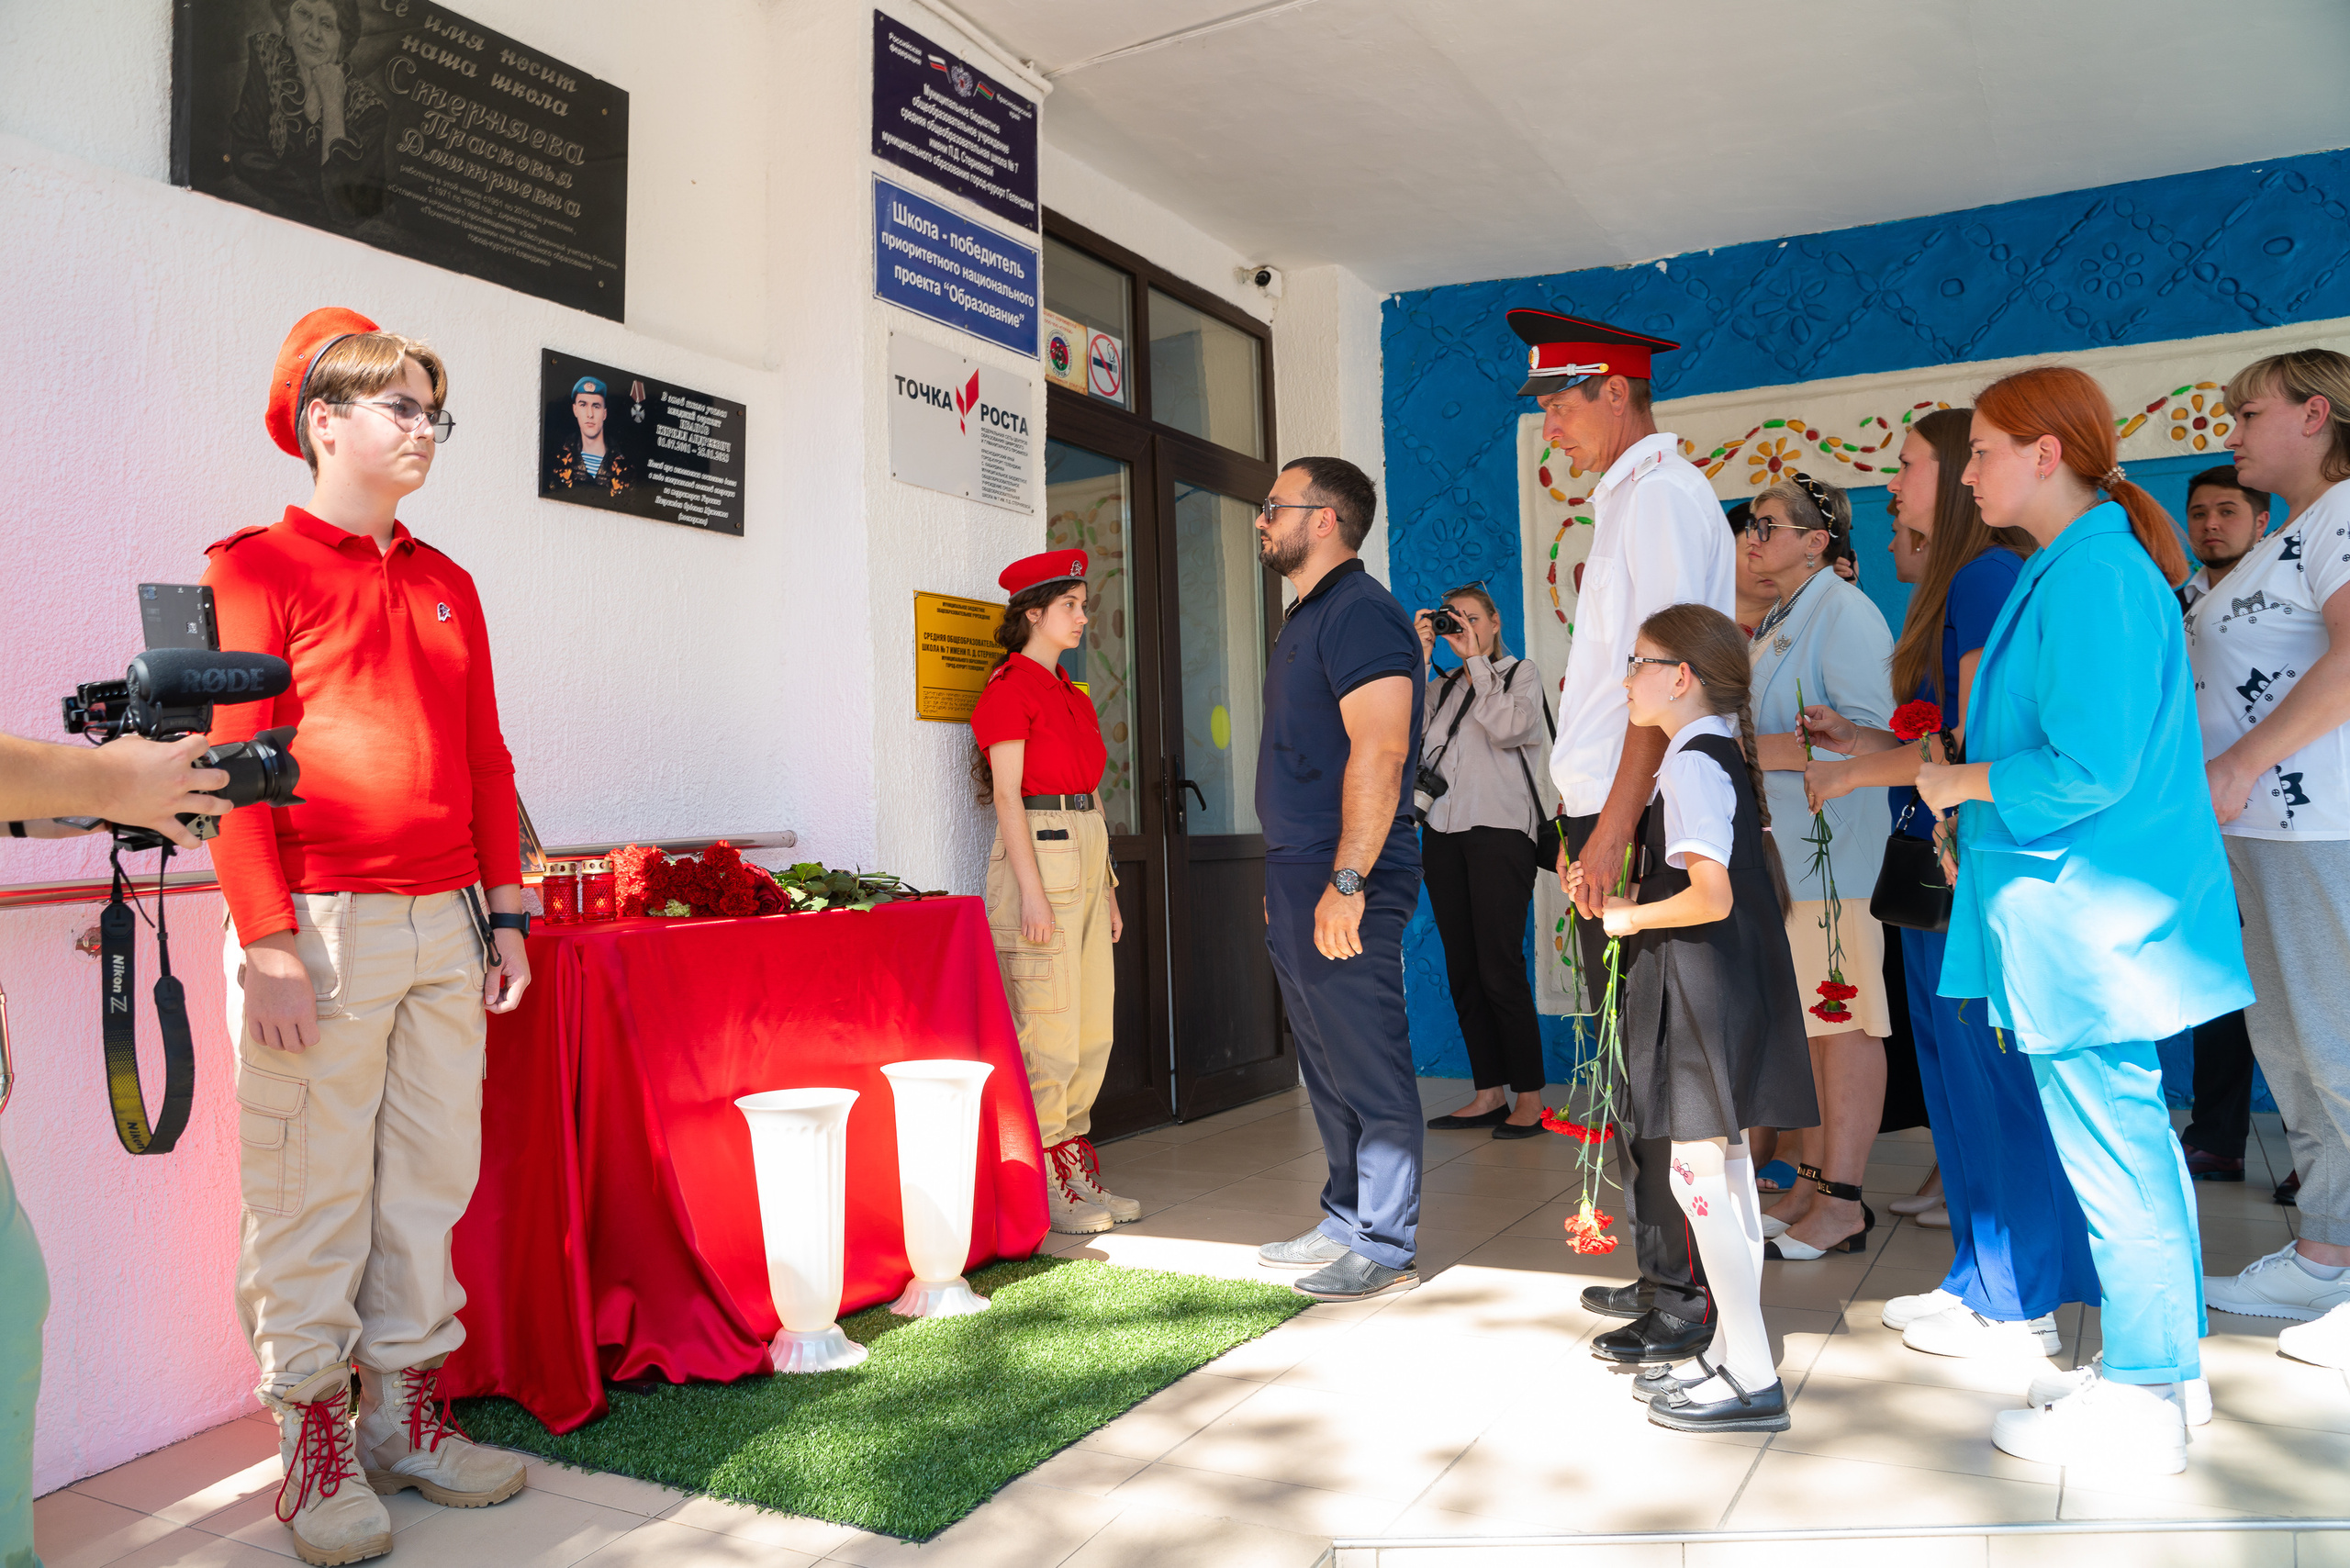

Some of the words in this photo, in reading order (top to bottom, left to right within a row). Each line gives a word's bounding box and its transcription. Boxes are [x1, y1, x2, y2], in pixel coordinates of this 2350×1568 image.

[401, 33, 478, 79] наша
[490, 71, 570, 117] школа
[423, 14, 486, 52] имя
[499, 49, 578, 94] носит
[386, 57, 586, 166] Стерняева
[901, 107, 926, 127] средняя
[927, 120, 990, 159] общеобразовательная
[990, 153, 1007, 168] школа
[912, 96, 977, 136] общеобразовательное
[978, 131, 1009, 153] учреждение
[923, 84, 968, 117] Муниципальное
[969, 109, 1000, 133] бюджетное
[396, 129, 581, 218] Дмитриевна
[420, 110, 573, 188] Прасковья
[882, 132, 933, 162] муниципального
[934, 155, 969, 180] образования
[970, 174, 1005, 197] город-курорт
[1006, 189, 1034, 211] Геленджик
[929, 139, 947, 154] имени
[961, 151, 993, 176] Стерняевой
[882, 232, 960, 274] приоритетного
[963, 268, 1034, 307] национального
[893, 202, 938, 240] Школа
[951, 234, 1024, 278] победитель
[895, 266, 940, 295] проекта
[945, 284, 1024, 327] “Образование”
[896, 375, 952, 410] ТОЧКА
[981, 404, 1027, 435] РОСТА
[922, 644, 939, 652] ШКОЛА
[950, 647, 966, 655] ИМЕНИ
[924, 633, 946, 642] СРЕДНЯЯ
[181, 667, 264, 693] RØDE
[112, 955, 125, 993] Nikon
